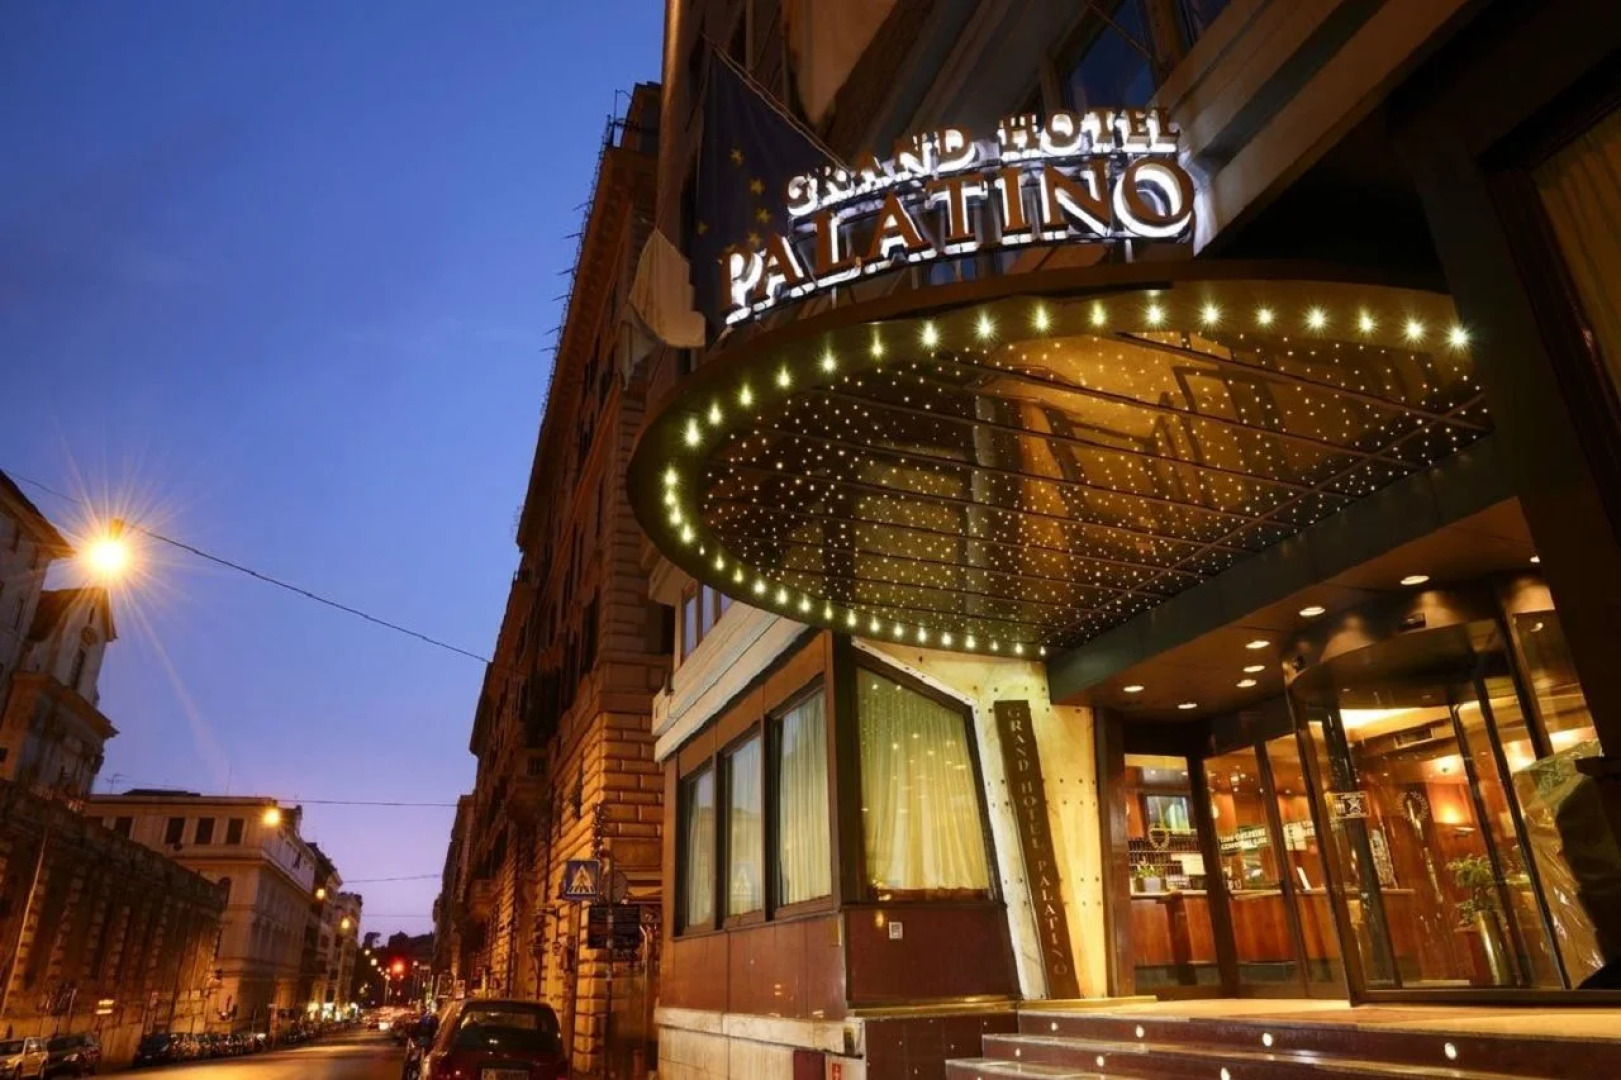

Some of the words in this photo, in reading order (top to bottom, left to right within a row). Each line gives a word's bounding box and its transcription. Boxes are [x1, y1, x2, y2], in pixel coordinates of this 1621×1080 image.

[719, 155, 1195, 325] PALATINO
[787, 127, 975, 217] GRAND
[997, 107, 1181, 162] HOTEL
[1007, 706, 1030, 772] GRAND
[1021, 780, 1041, 849] HOTEL
[1038, 860, 1069, 975] PALATINO
